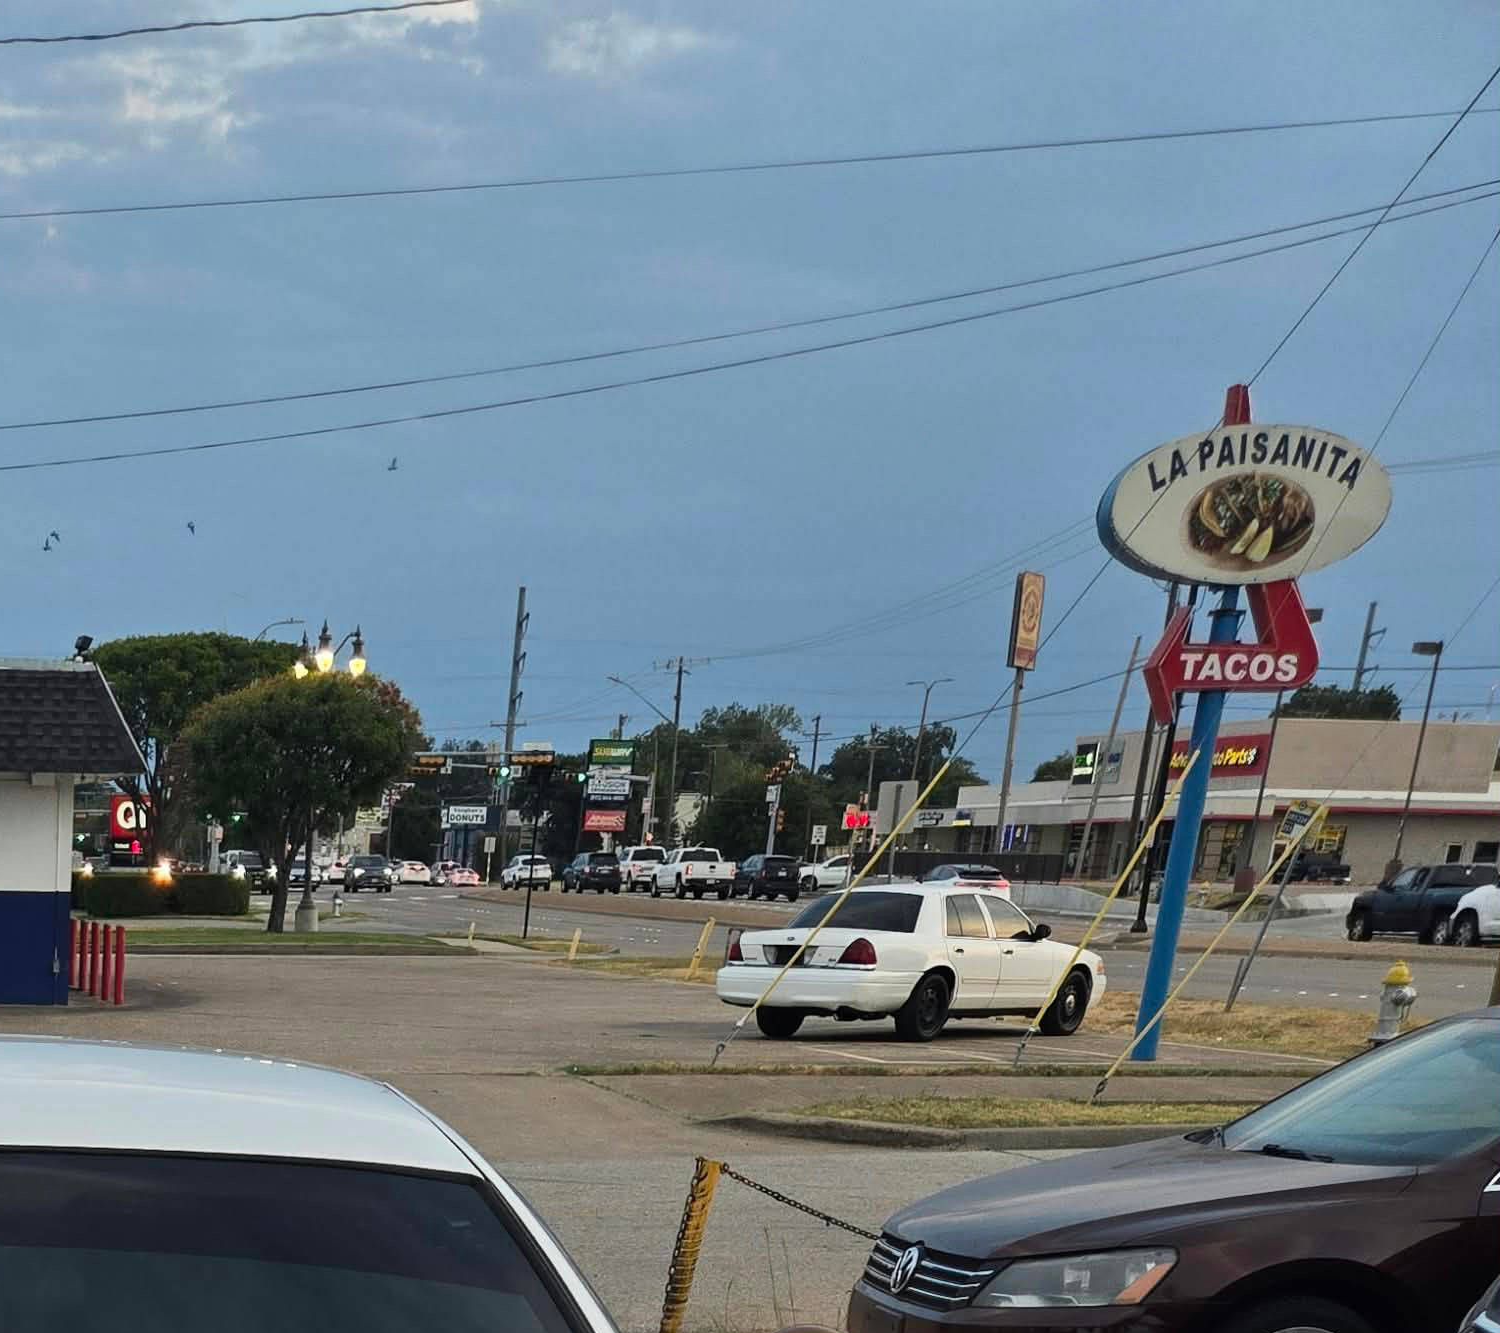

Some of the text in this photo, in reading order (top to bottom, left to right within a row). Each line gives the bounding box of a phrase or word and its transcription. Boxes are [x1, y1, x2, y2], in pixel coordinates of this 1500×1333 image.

[1148, 432, 1362, 492] LA PAISANITA
[1179, 652, 1298, 681] TACOS
[1223, 747, 1248, 766] Parts
[450, 814, 485, 822] DONUTS
